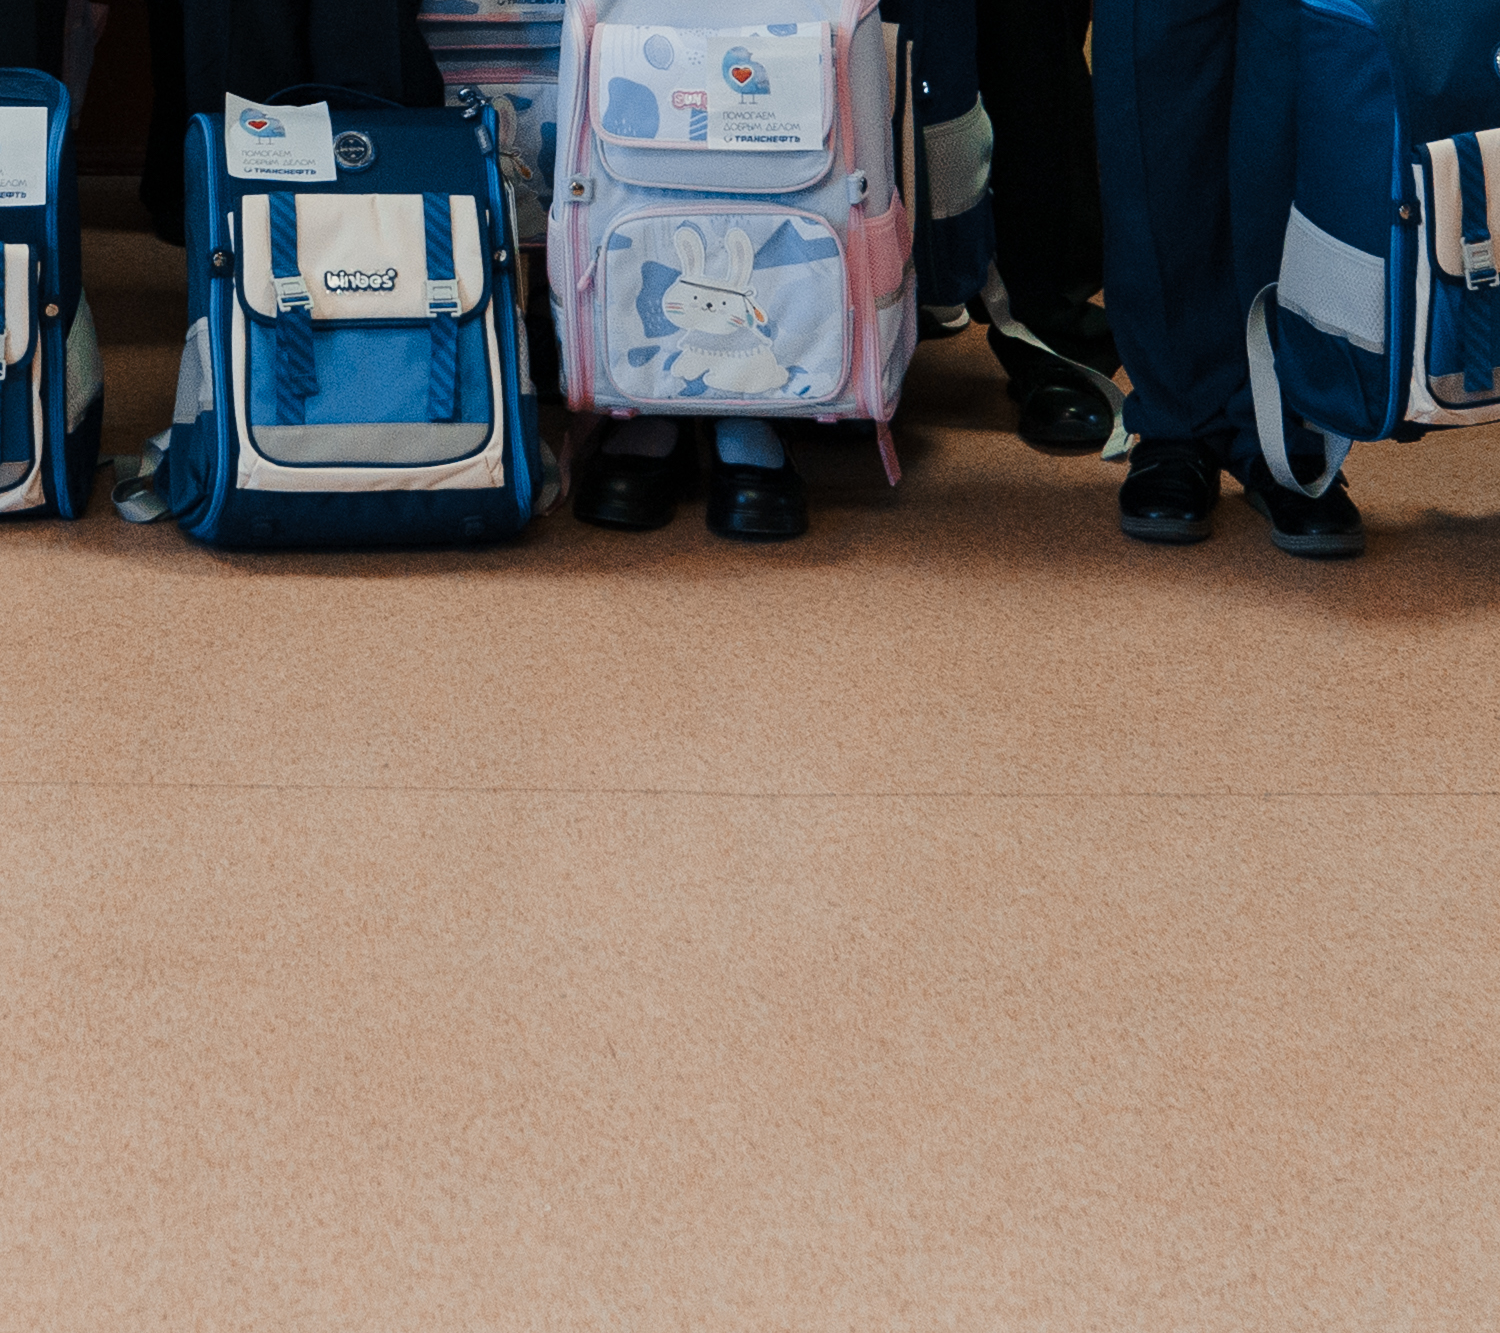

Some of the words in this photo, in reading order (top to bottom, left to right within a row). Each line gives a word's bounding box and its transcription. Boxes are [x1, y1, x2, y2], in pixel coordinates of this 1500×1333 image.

[673, 93, 707, 107] SUN
[722, 111, 776, 120] ПОМОГАЕМ
[723, 122, 763, 132] ДОБРЫМ
[766, 122, 801, 131] ДЕЛОМ
[735, 135, 801, 144] ТРАНСНЕФТЬ
[241, 149, 292, 158] ПОМОГАЕМ
[254, 167, 317, 175] ТРАНСНЕФТЬ
[326, 269, 397, 290] binbes
